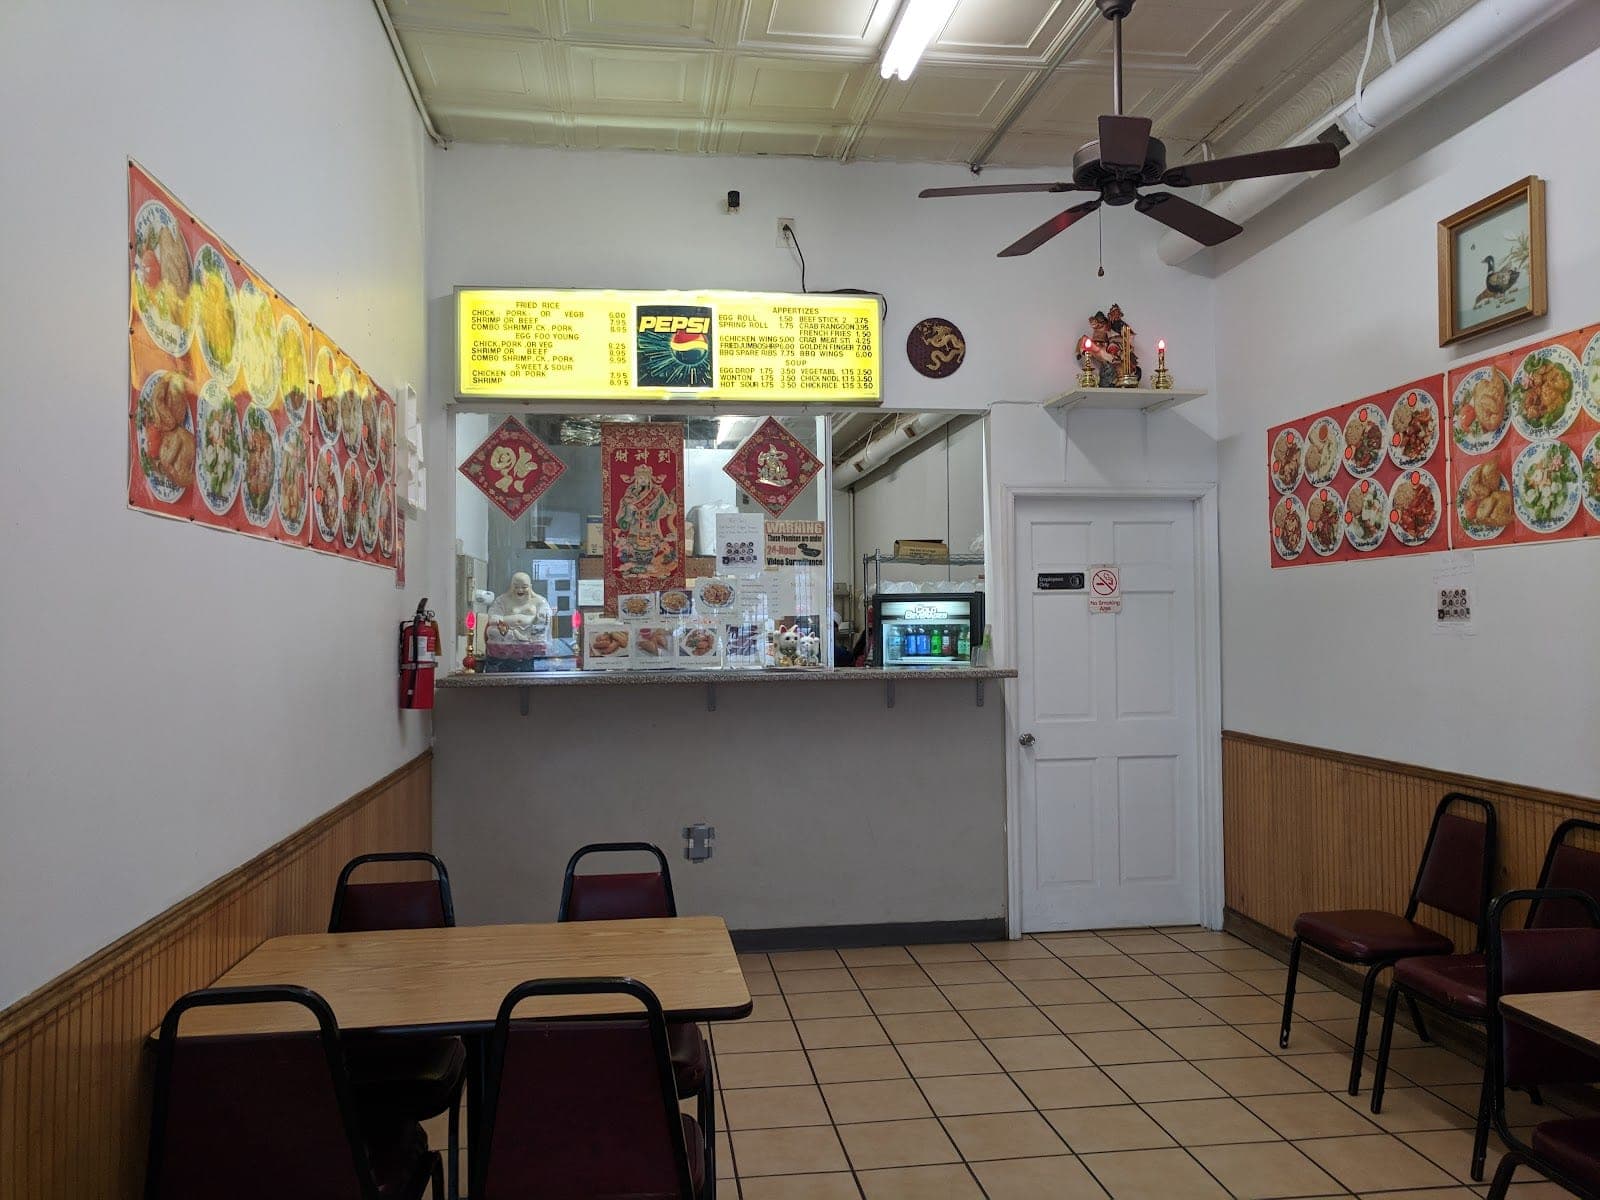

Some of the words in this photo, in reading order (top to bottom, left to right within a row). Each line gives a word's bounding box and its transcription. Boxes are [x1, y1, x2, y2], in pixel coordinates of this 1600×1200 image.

[542, 302, 560, 310] RICE
[639, 316, 710, 334] PEPSI
[767, 522, 822, 533] WARNING
[767, 544, 797, 556] 24-Hour
[767, 557, 784, 566] Video
